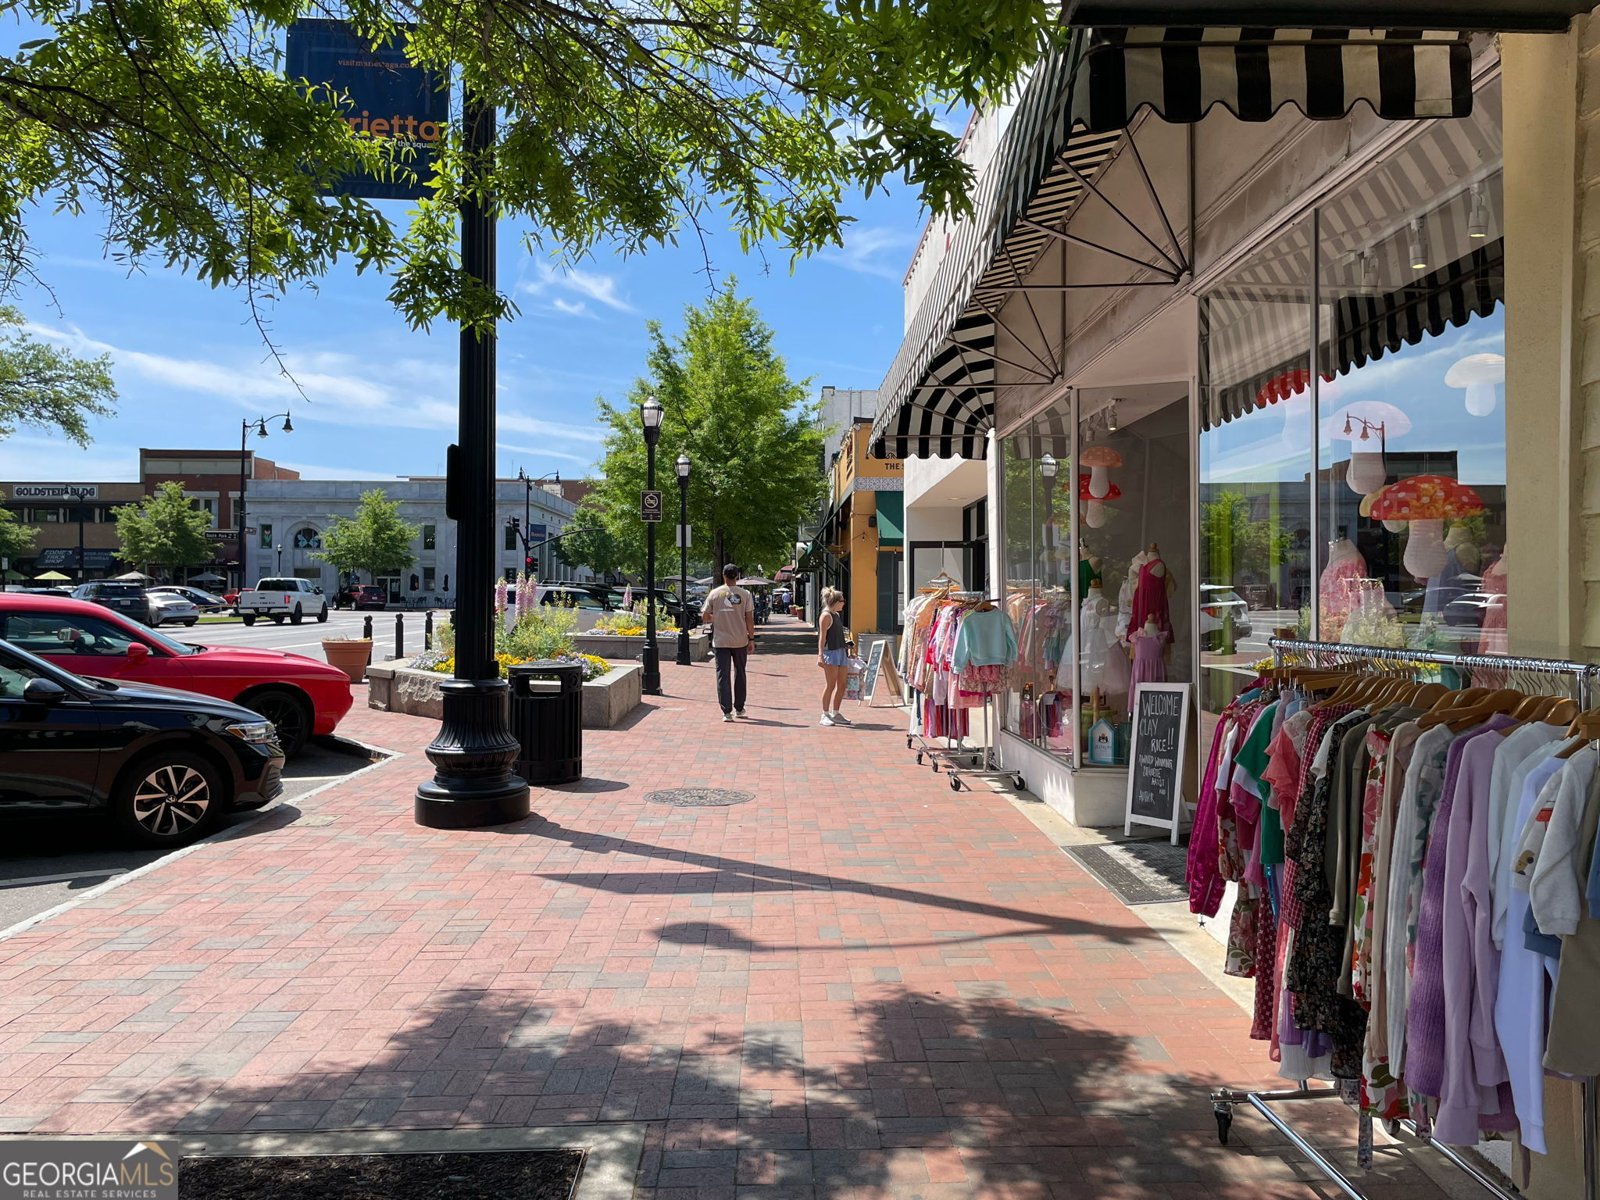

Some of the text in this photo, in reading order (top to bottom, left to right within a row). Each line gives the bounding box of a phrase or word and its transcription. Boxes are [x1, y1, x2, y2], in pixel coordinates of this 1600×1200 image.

[338, 110, 440, 141] rietta
[70, 487, 95, 497] BLDG
[1141, 693, 1179, 717] WELCOME
[1139, 718, 1159, 737] CLAY
